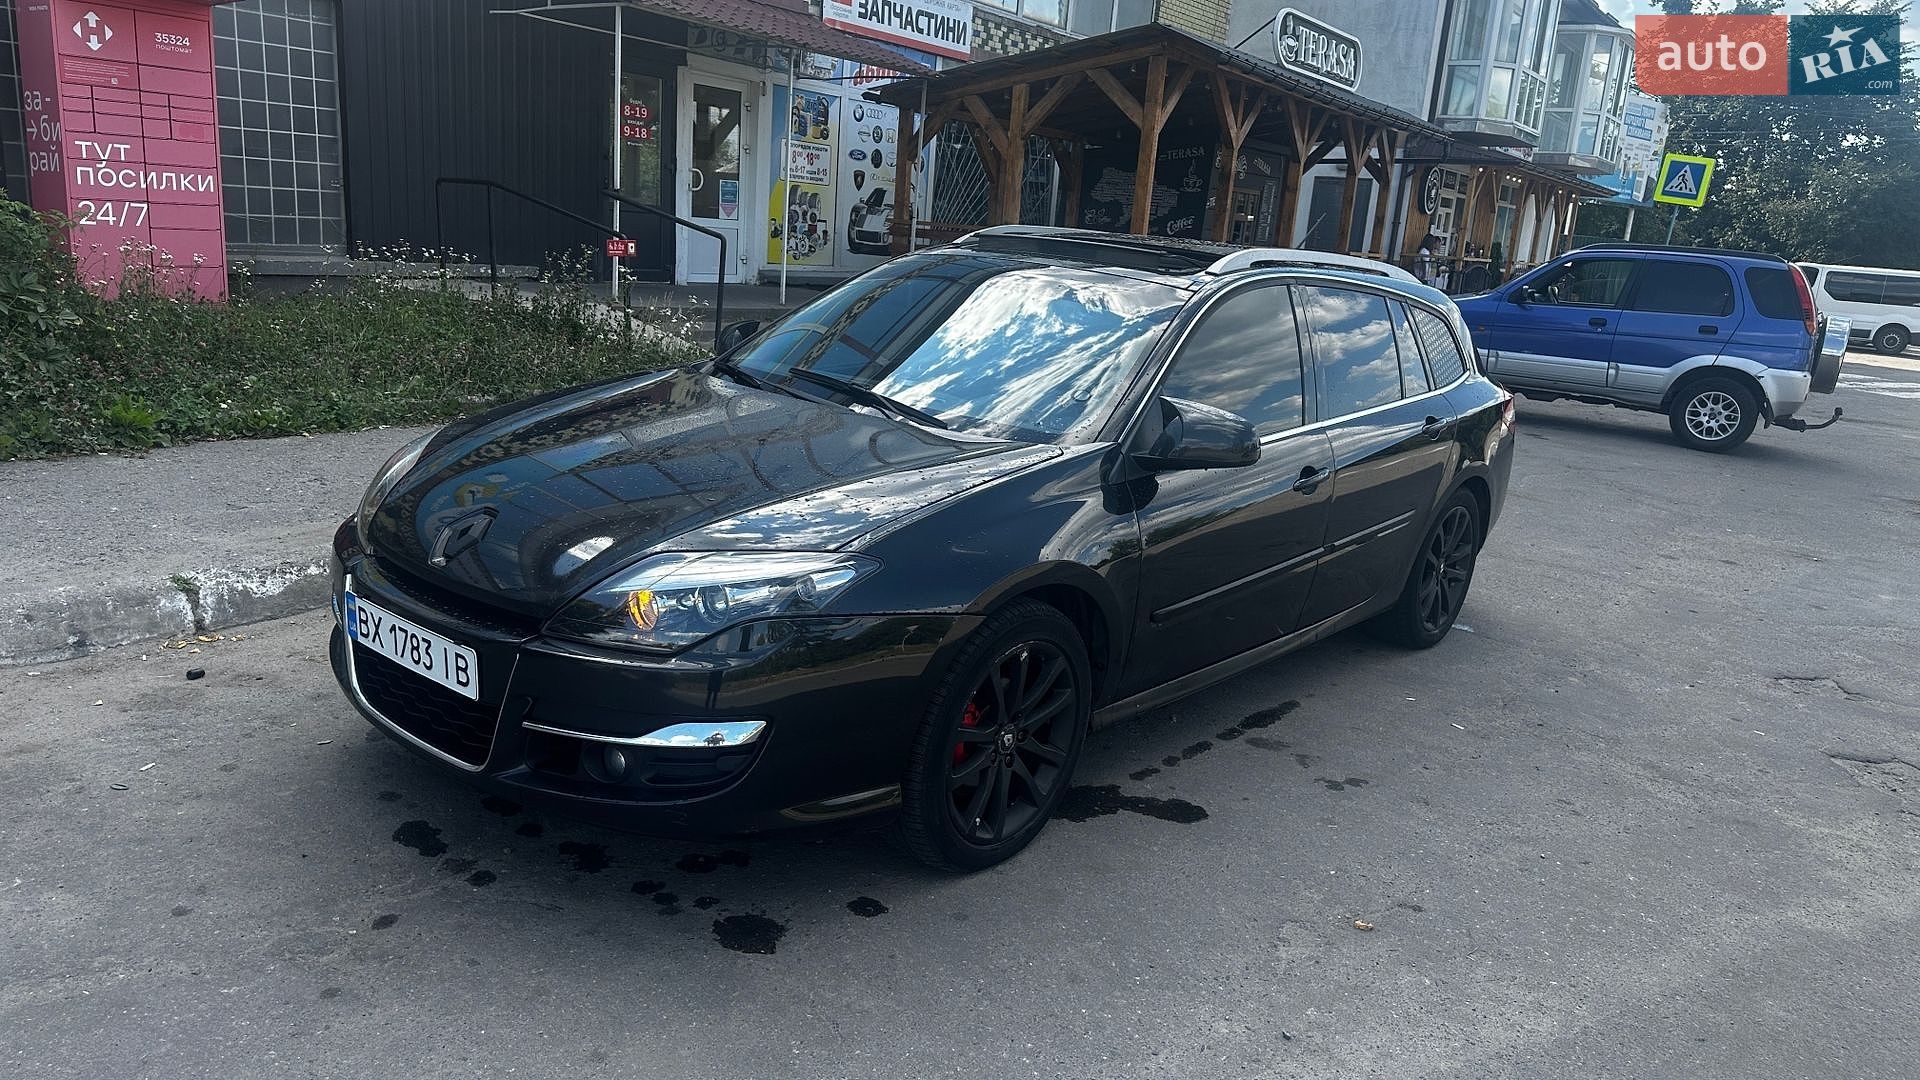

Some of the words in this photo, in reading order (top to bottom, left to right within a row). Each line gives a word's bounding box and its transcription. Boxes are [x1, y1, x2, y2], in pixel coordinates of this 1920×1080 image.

[857, 0, 968, 46] ЗАПЧАСТИНИ
[154, 32, 190, 47] 35324
[1298, 26, 1355, 80] TERASA
[624, 105, 648, 118] 8-19
[623, 125, 648, 139] 9-18
[29, 145, 60, 177] рай
[77, 200, 149, 227] 24/7
[1166, 215, 1196, 235] Coffee
[358, 606, 384, 648] BX
[389, 623, 433, 670] 1783
[443, 647, 470, 687] IB
